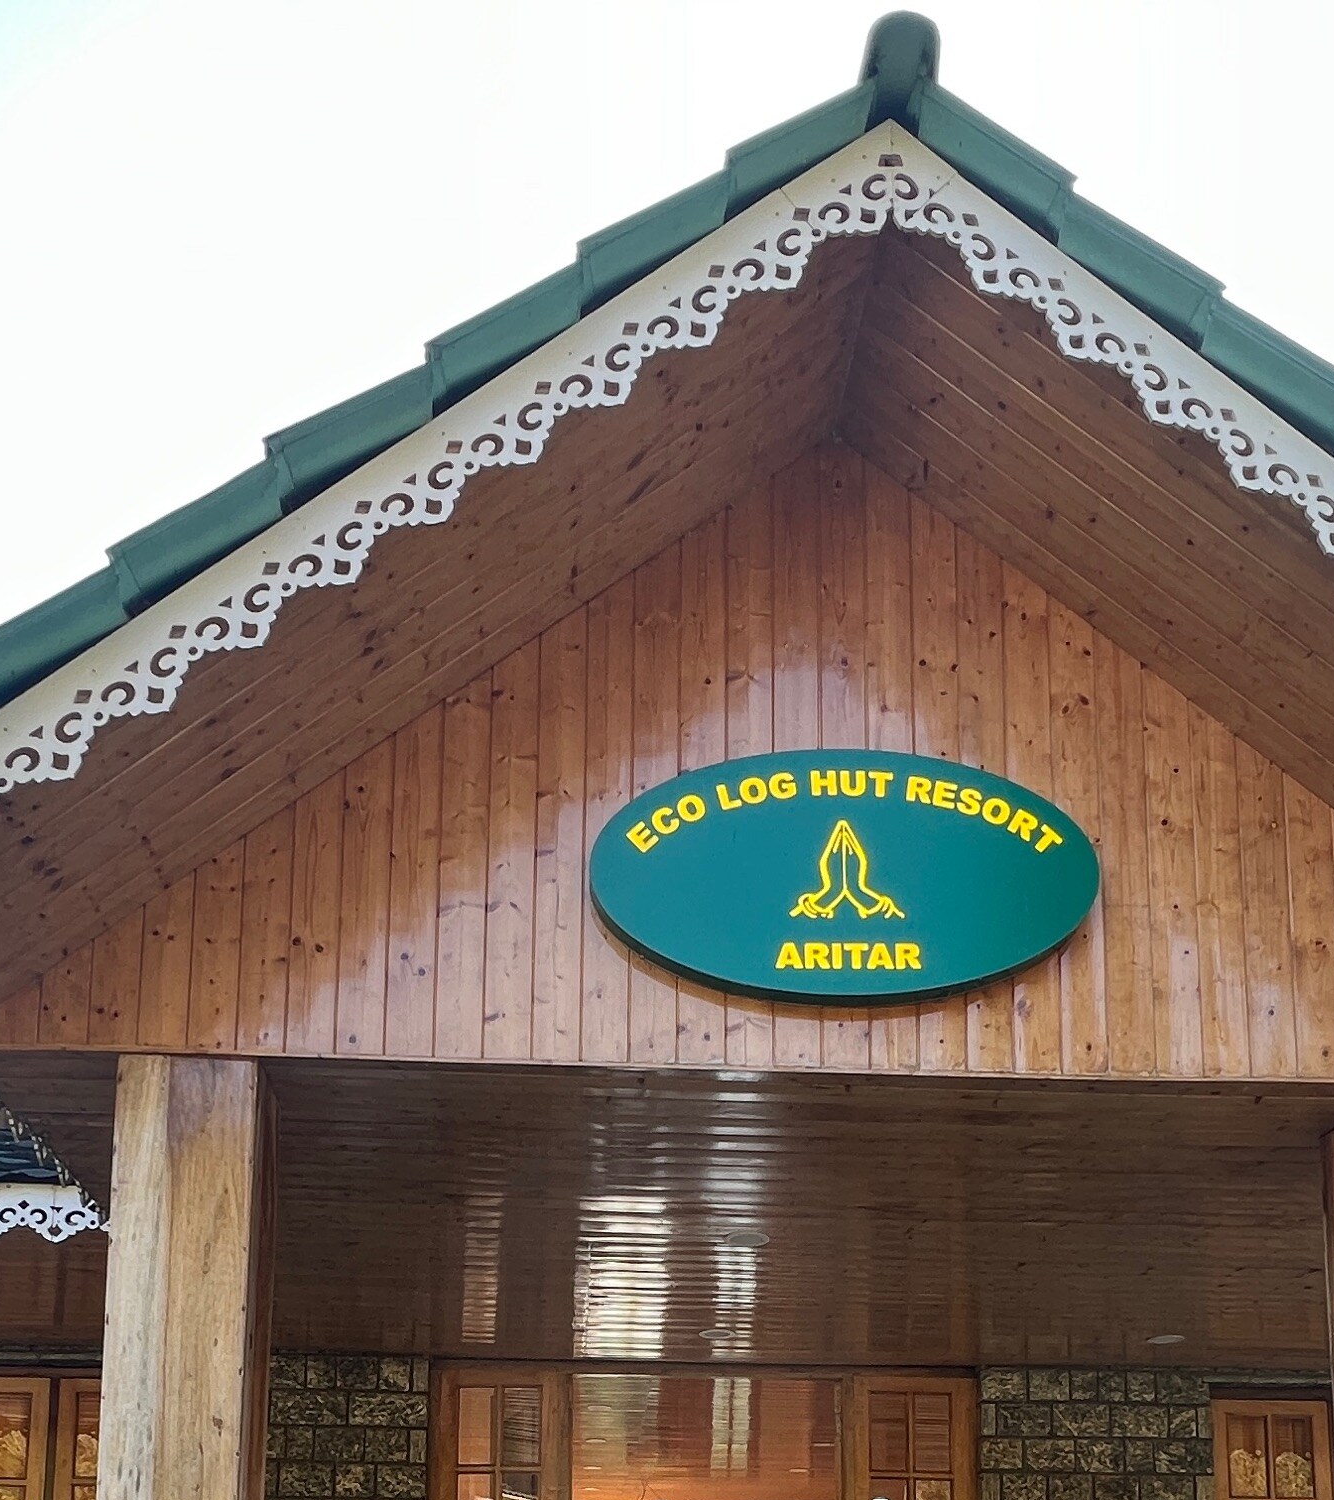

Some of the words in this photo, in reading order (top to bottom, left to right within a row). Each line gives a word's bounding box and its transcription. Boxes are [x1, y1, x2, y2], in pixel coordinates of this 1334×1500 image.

[626, 794, 707, 853] ECO
[716, 771, 798, 811] LOG
[809, 769, 894, 798] HUT
[905, 774, 1065, 853] RESORT
[775, 941, 923, 971] ARITAR
